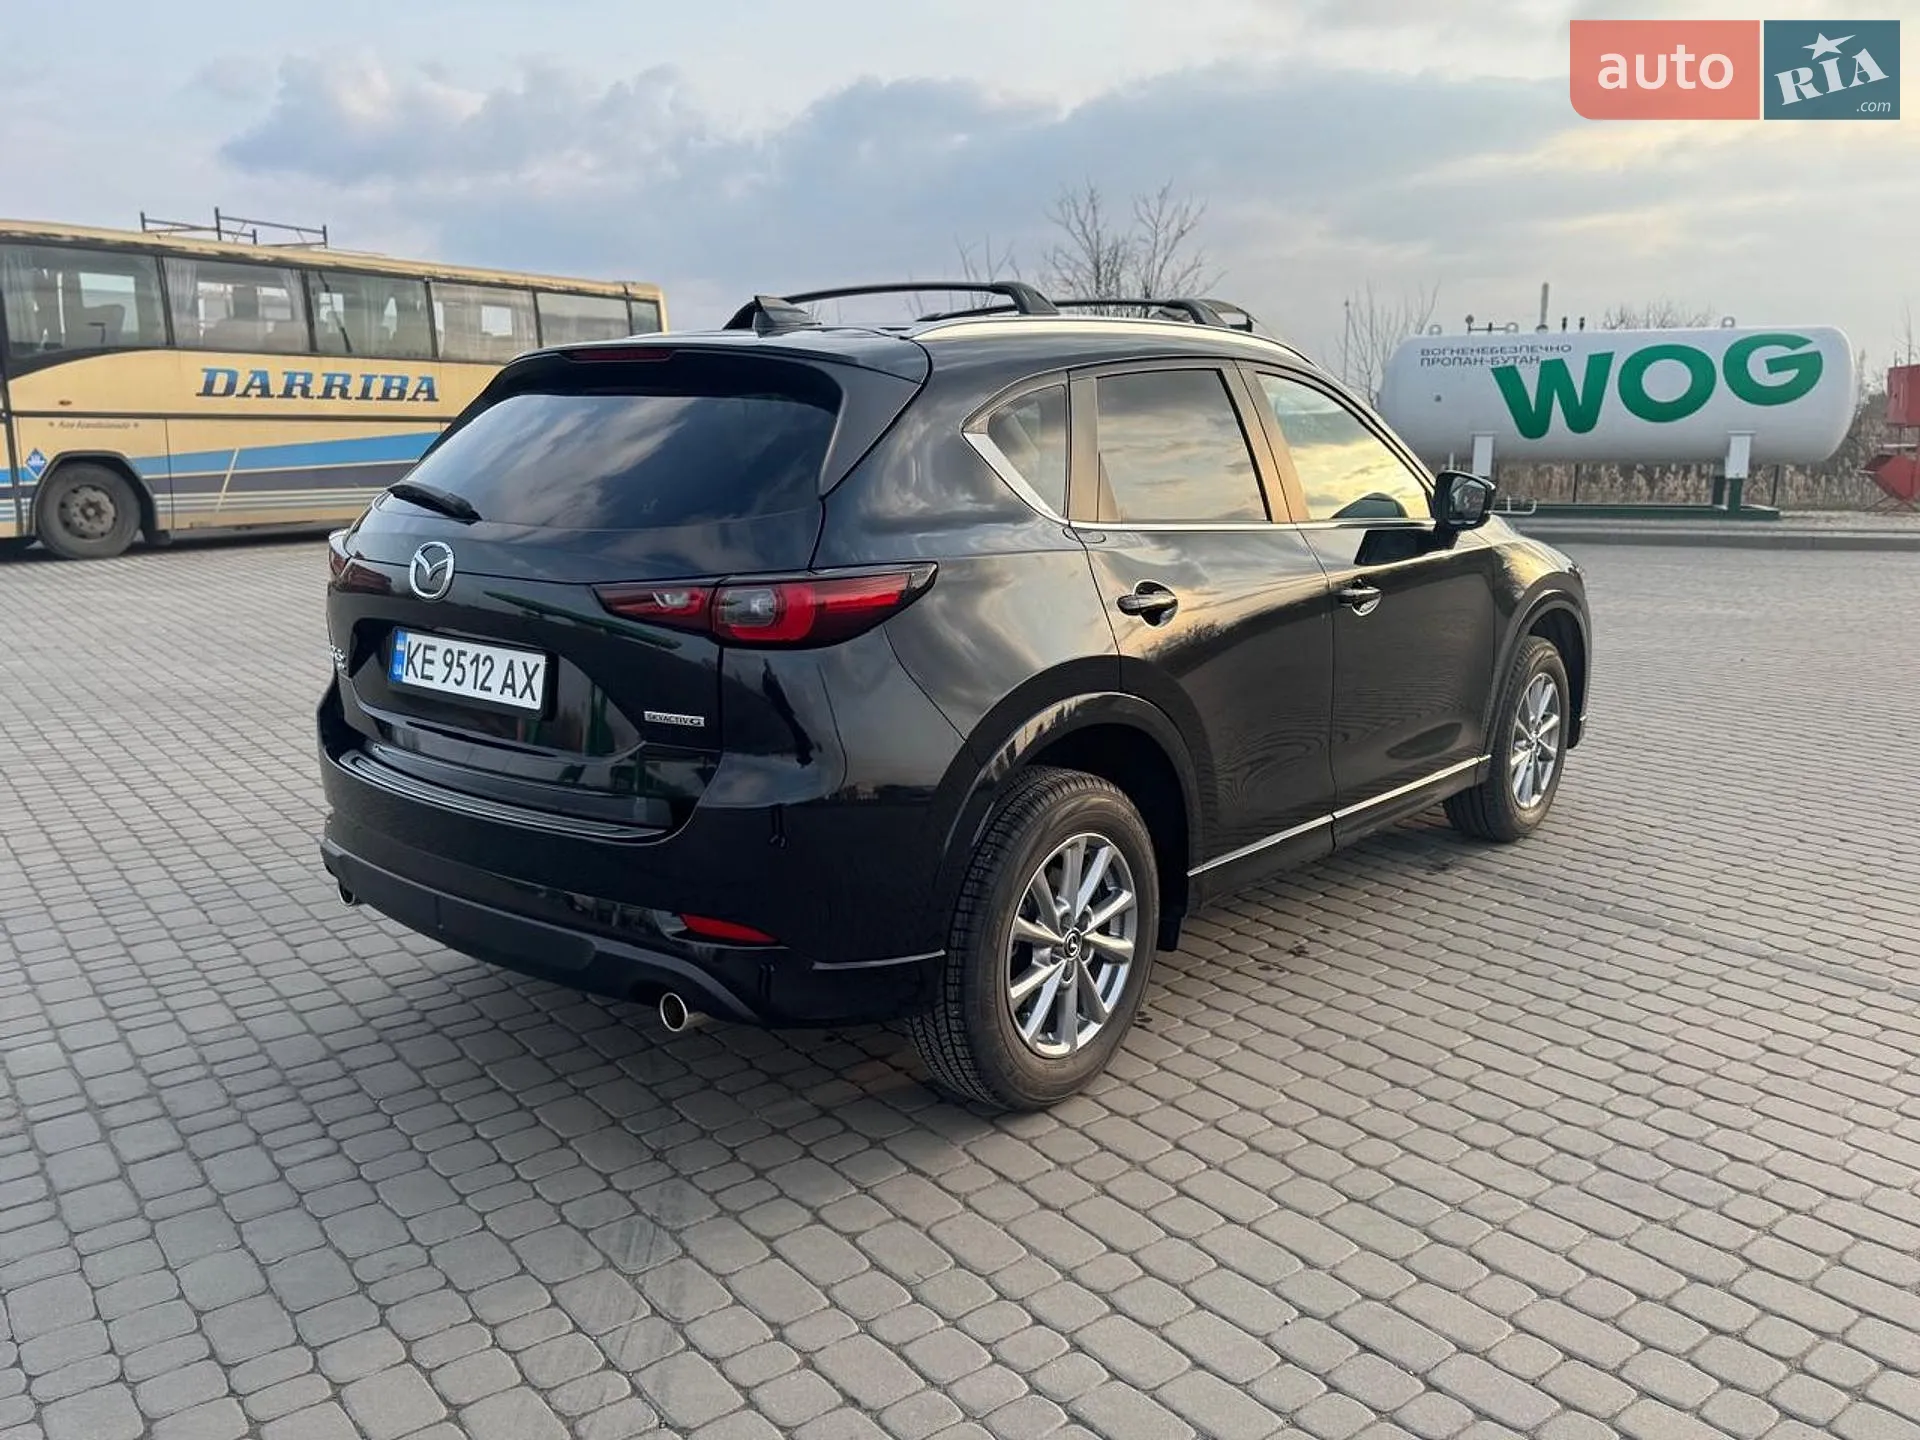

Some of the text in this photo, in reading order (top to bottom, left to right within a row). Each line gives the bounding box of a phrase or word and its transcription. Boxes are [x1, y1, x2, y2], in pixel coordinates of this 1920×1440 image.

[1420, 344, 1572, 356] ВОГНЕНЕБЕЗПЕЧНО
[1420, 355, 1540, 367] ПРОПАН-БУТАН
[196, 367, 440, 402] DARRIBA
[1491, 333, 1823, 440] WOG
[405, 641, 540, 702] KE 9512 AX
